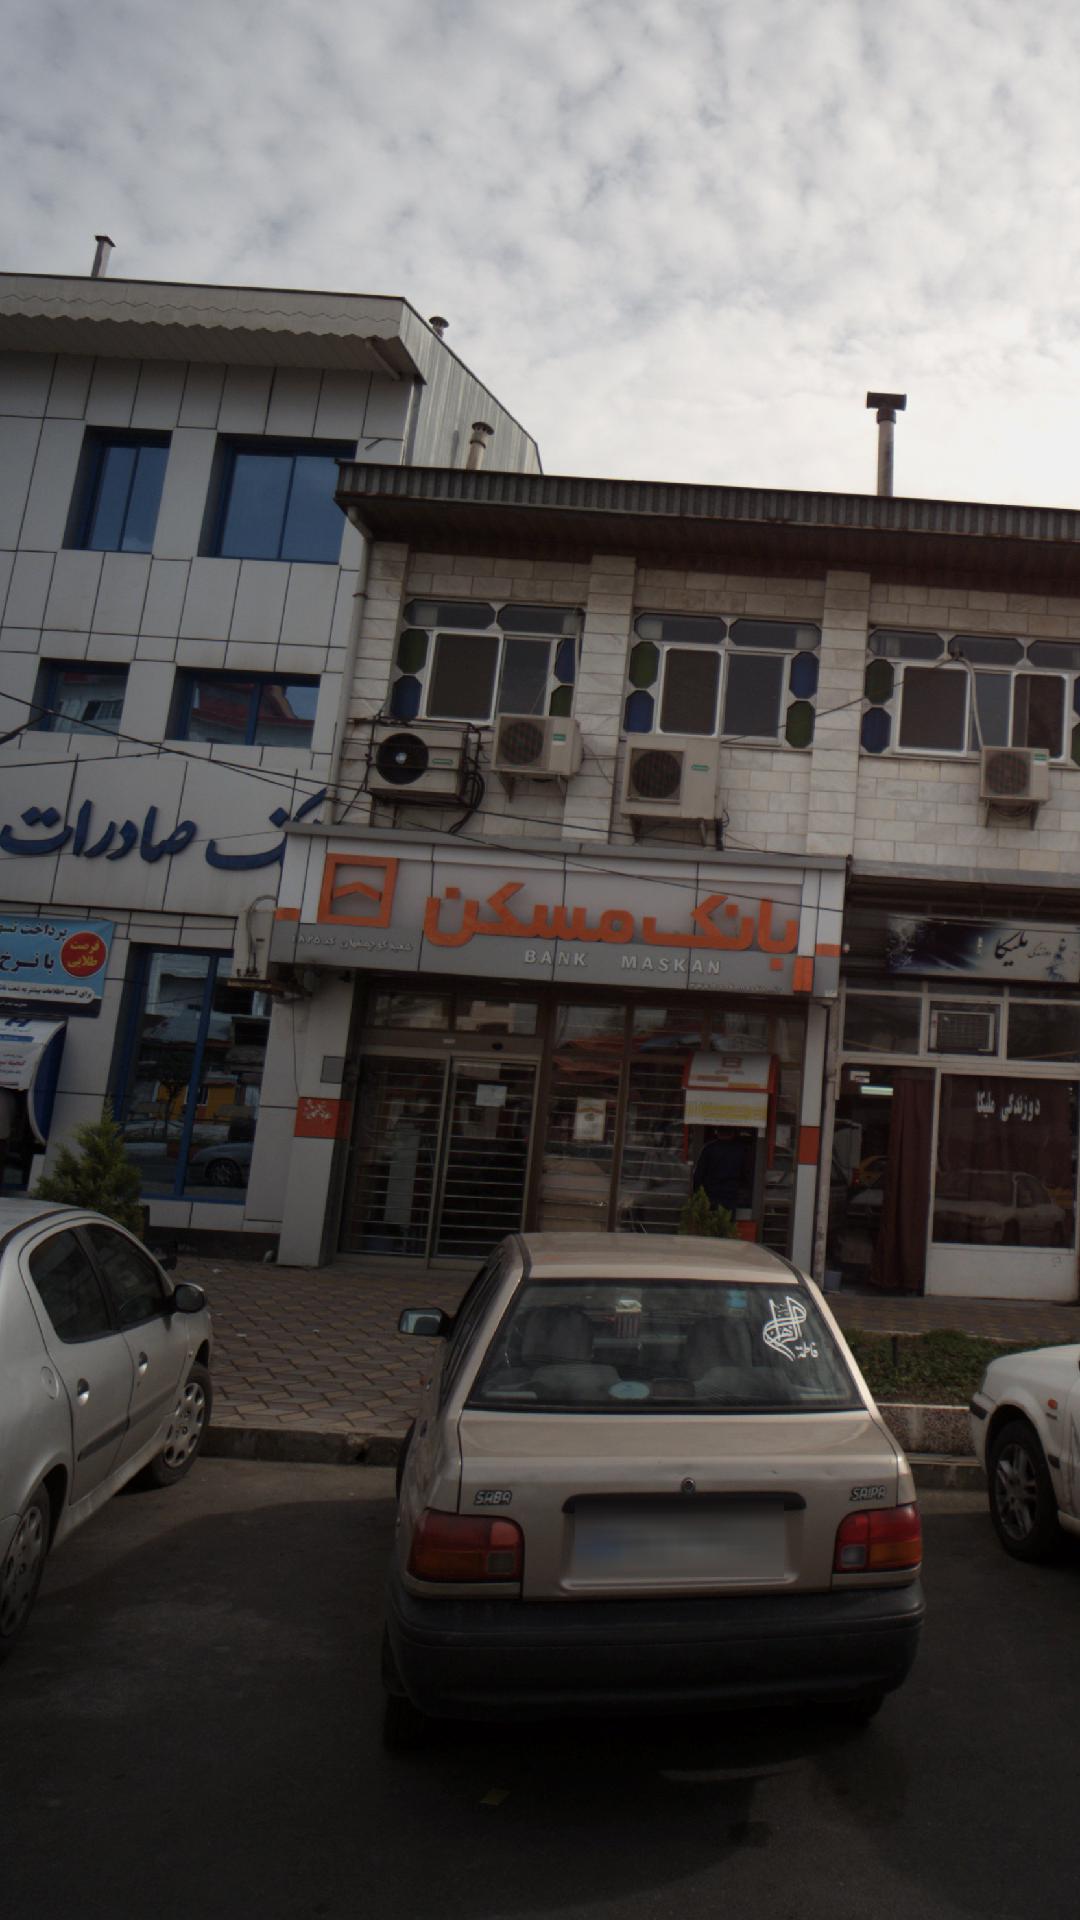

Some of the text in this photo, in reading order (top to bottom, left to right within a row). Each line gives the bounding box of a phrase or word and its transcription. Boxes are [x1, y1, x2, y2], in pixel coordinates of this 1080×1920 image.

[0, 799, 198, 864] صادرات
[21, 923, 68, 942] پرداخت
[423, 881, 798, 971] بانک مسکن
[70, 939, 100, 954] فرصت
[0, 952, 54, 974] با نرخ
[67, 955, 98, 968] طلایی
[524, 950, 721, 975] BANK MASKAN
[976, 1090, 1040, 1121] دوزندگی ملیکا
[476, 1490, 512, 1505] SABA
[849, 1485, 889, 1502] SAIPA
